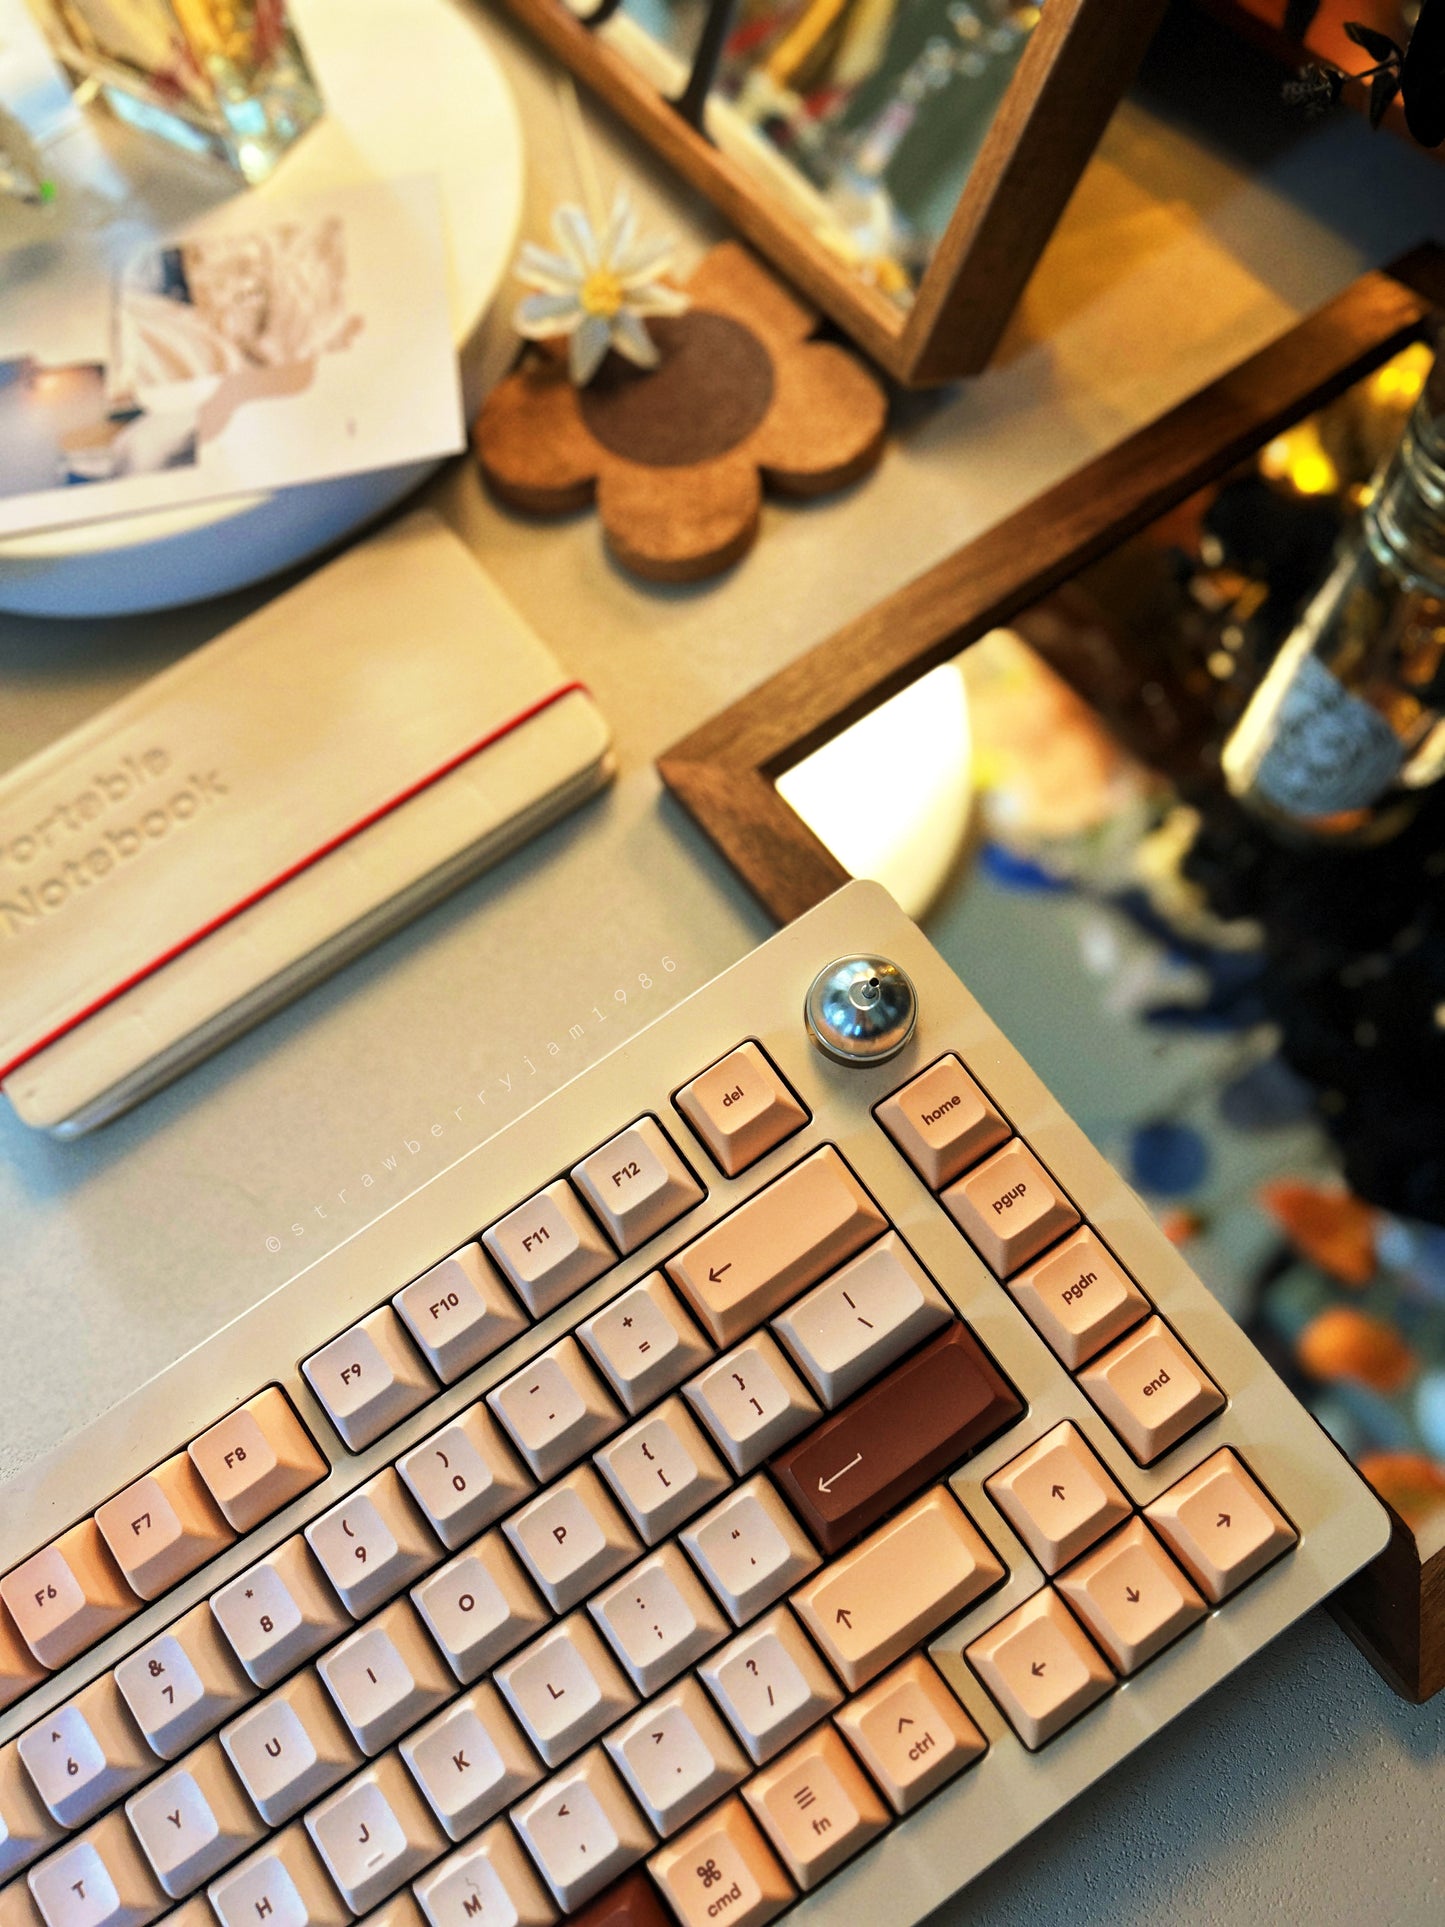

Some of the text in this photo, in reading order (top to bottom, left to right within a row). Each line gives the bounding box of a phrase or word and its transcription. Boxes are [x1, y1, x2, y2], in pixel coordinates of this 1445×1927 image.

[0, 748, 168, 864] ortable
[722, 1085, 745, 1108] del
[921, 1094, 962, 1126] home
[611, 1161, 641, 1188] F12
[991, 1183, 1027, 1215] pgup
[521, 1226, 551, 1253] F11
[1061, 1272, 1098, 1306] pgdn
[429, 1292, 459, 1320] F10
[622, 1316, 633, 1328] +
[638, 1341, 651, 1353] =
[340, 1363, 362, 1386] F9
[731, 1373, 746, 1391] }
[1142, 1368, 1171, 1397] end
[749, 1397, 764, 1416] ]
[223, 1446, 247, 1469] F8
[435, 1451, 449, 1469] )
[641, 1442, 655, 1461] {
[656, 1468, 672, 1488] [
[130, 1512, 151, 1536] F7
[342, 1519, 355, 1538] (
[552, 1526, 567, 1545] P
[354, 1545, 367, 1564] 9
[34, 1584, 57, 1607] F6
[458, 1593, 475, 1612] O
[636, 1597, 646, 1610] :
[259, 1615, 274, 1633] 8
[653, 1625, 663, 1640] ;
[148, 1659, 166, 1678] &
[745, 1659, 759, 1676] ?
[161, 1685, 174, 1704] 7
[546, 1683, 565, 1700] L
[264, 1737, 282, 1758] U
[908, 1731, 936, 1761] ctrl
[66, 1757, 79, 1776] 6
[452, 1750, 471, 1773] K
[166, 1809, 182, 1829] Y
[812, 1817, 832, 1836] fn
[358, 1823, 370, 1844] J
[71, 1880, 85, 1899] T
[254, 1896, 273, 1920] H
[462, 1893, 483, 1918] M
[707, 1882, 742, 1918] cmd
